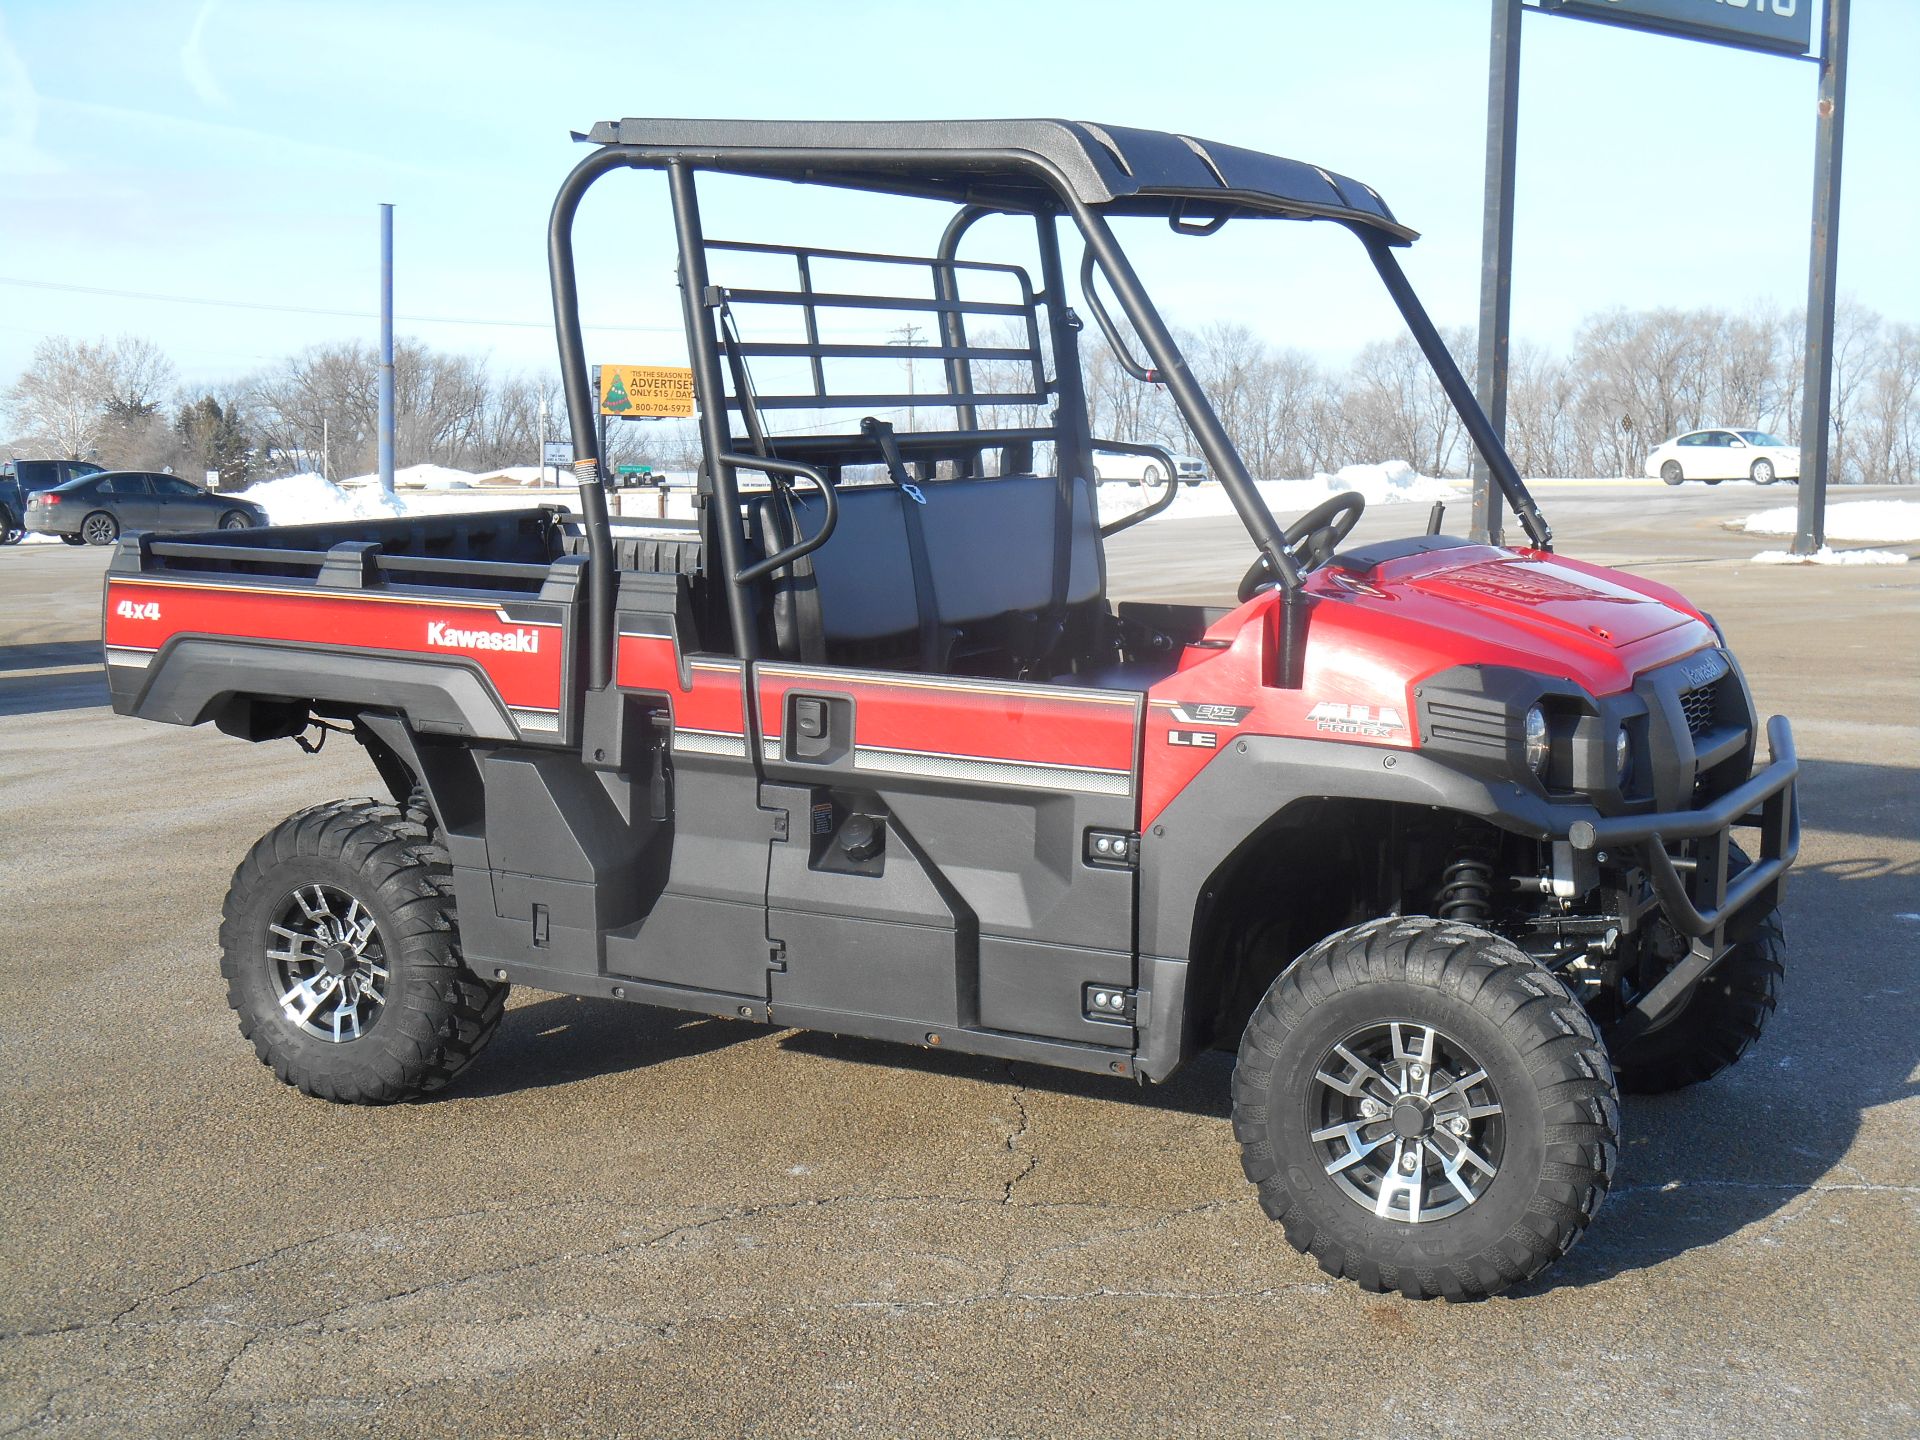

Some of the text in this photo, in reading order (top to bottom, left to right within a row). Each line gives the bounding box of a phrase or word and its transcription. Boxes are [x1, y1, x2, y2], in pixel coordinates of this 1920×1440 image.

[630, 389, 651, 397] ONLY
[653, 390, 669, 398] $15
[635, 404, 691, 412] 800-704-5973
[117, 600, 161, 620] 4x4
[427, 621, 539, 653] Kawasaki
[1317, 723, 1359, 735] PRO
[1168, 731, 1216, 747] LE
